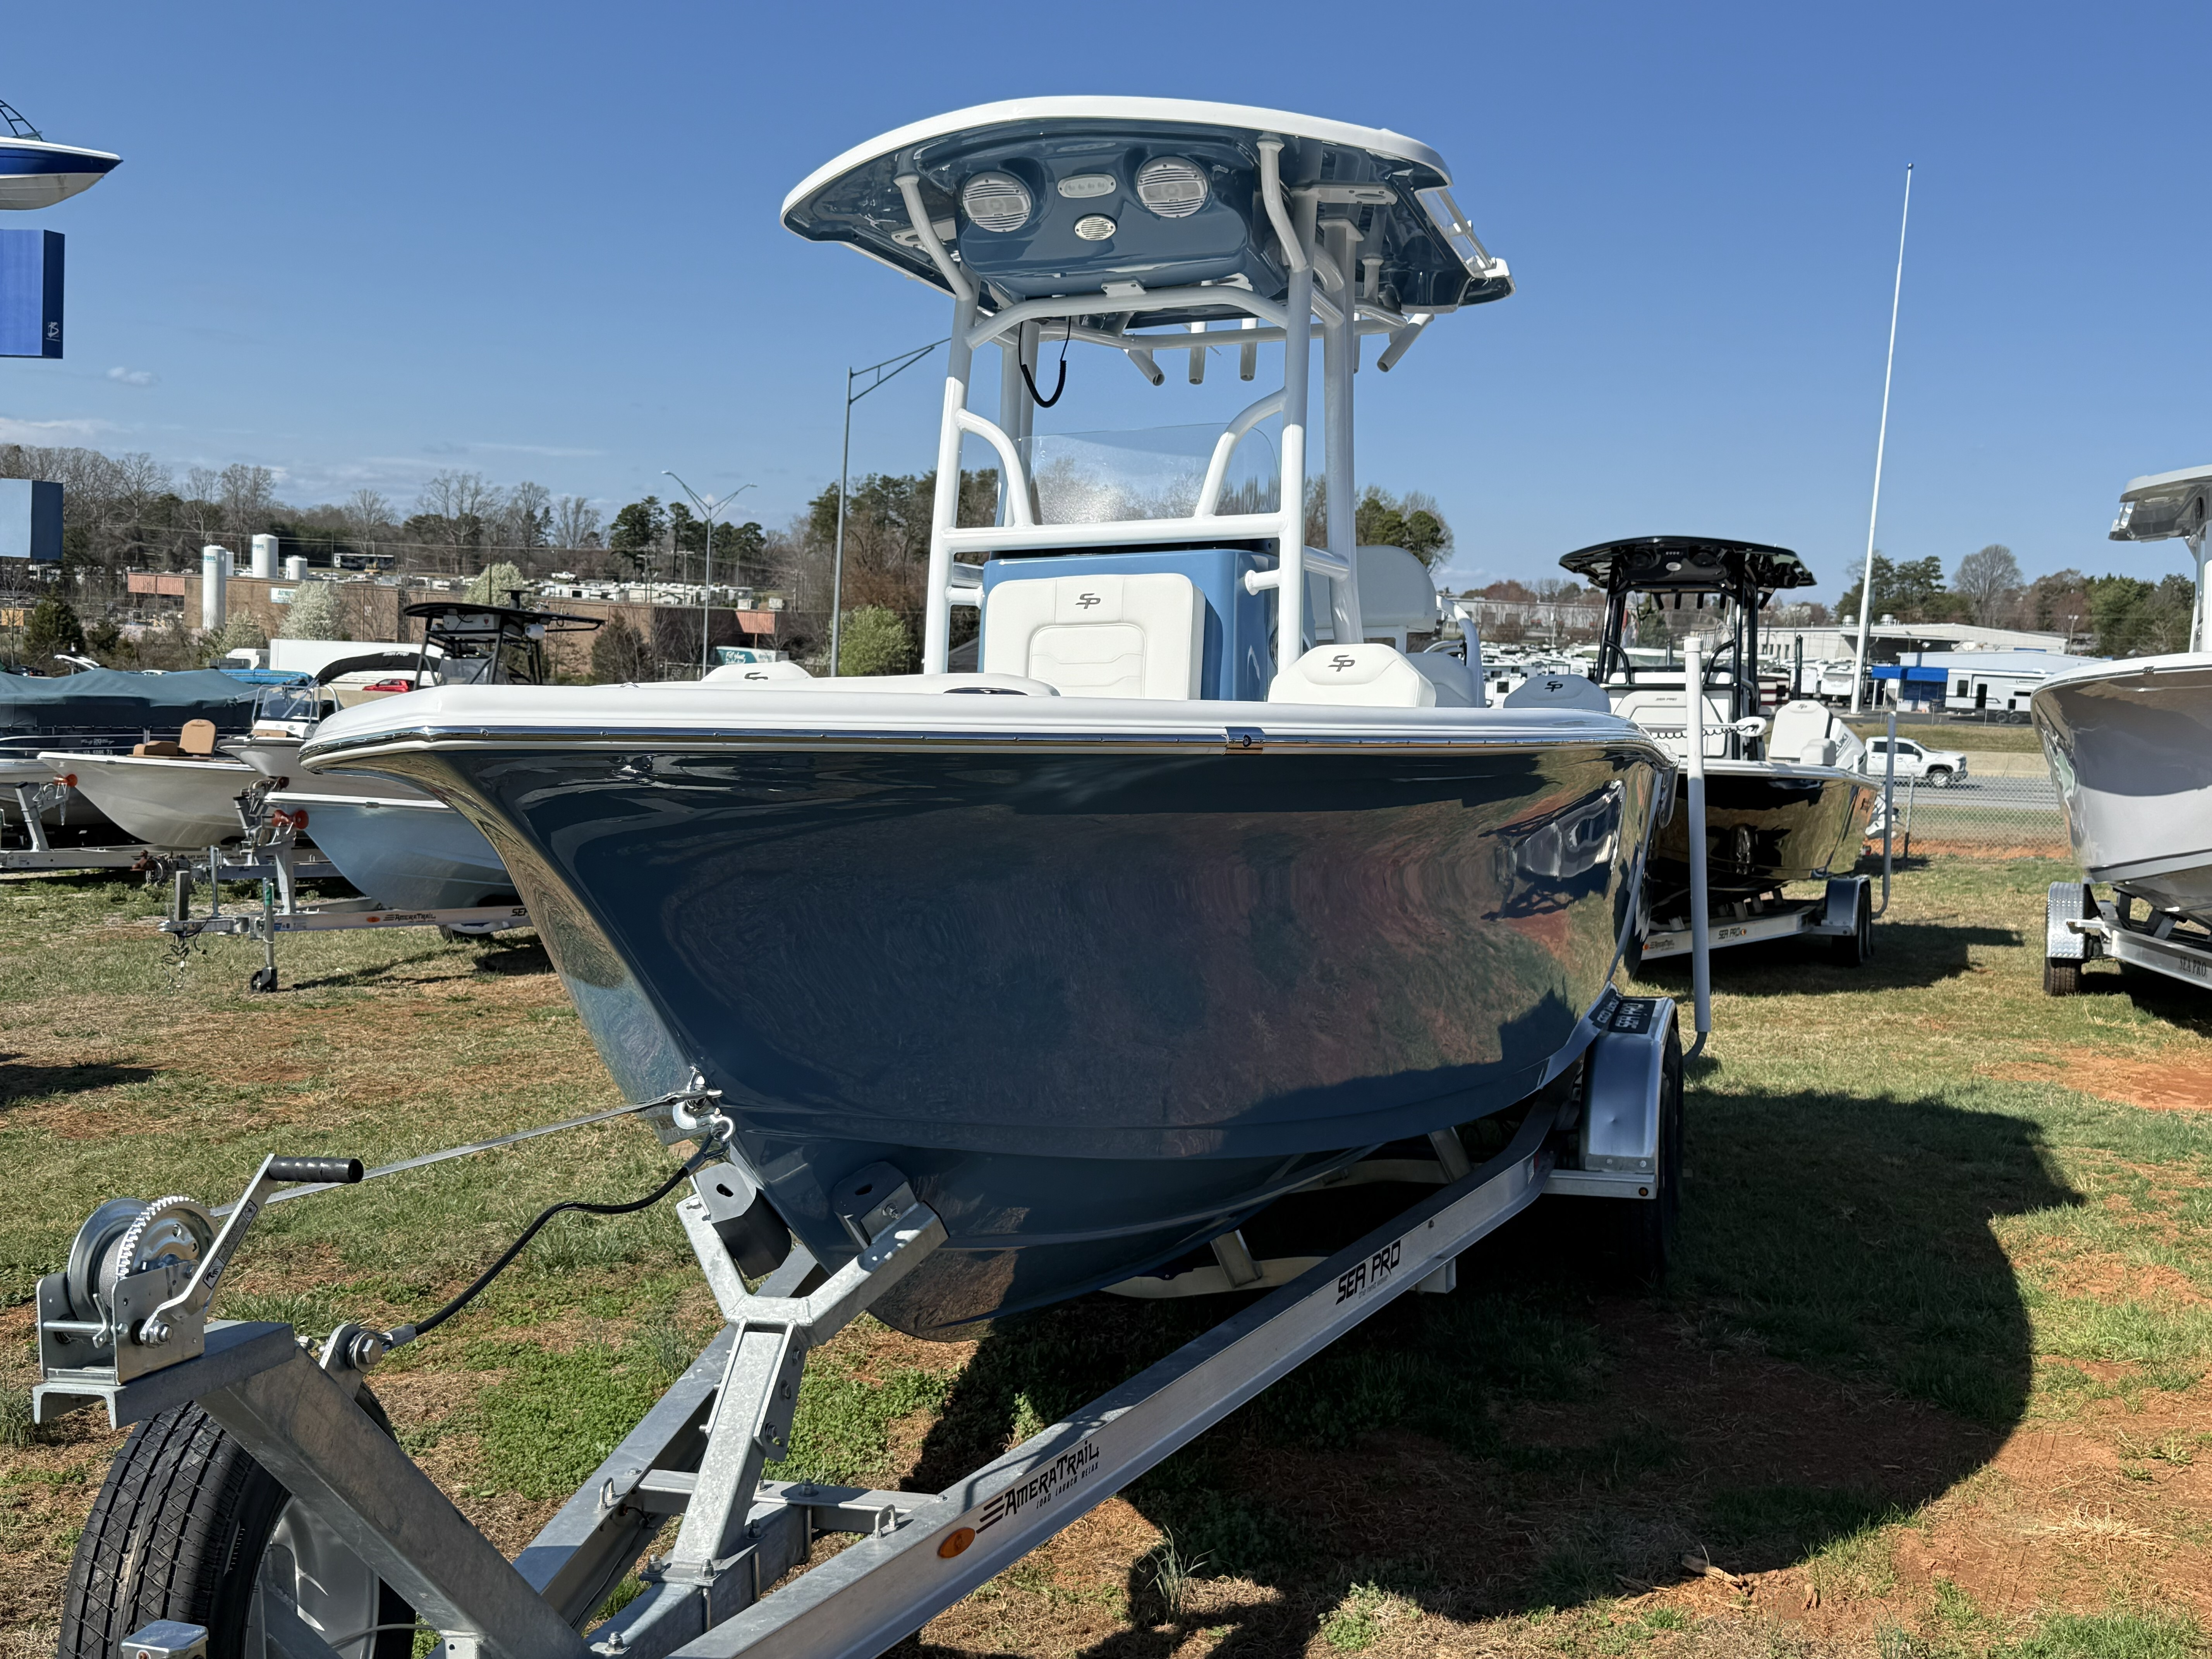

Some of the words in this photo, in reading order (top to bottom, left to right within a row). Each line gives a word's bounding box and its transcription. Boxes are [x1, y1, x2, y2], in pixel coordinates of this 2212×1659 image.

[1075, 593, 1101, 609] SP
[1328, 654, 1355, 672] SP
[1544, 680, 1563, 692] SP
[2192, 959, 2206, 977] PRO
[1335, 1262, 1366, 1305] SEA
[1371, 1239, 1401, 1283] PRO
[1036, 1493, 1051, 1509] LOAD
[1081, 1461, 1099, 1479] RELAX
